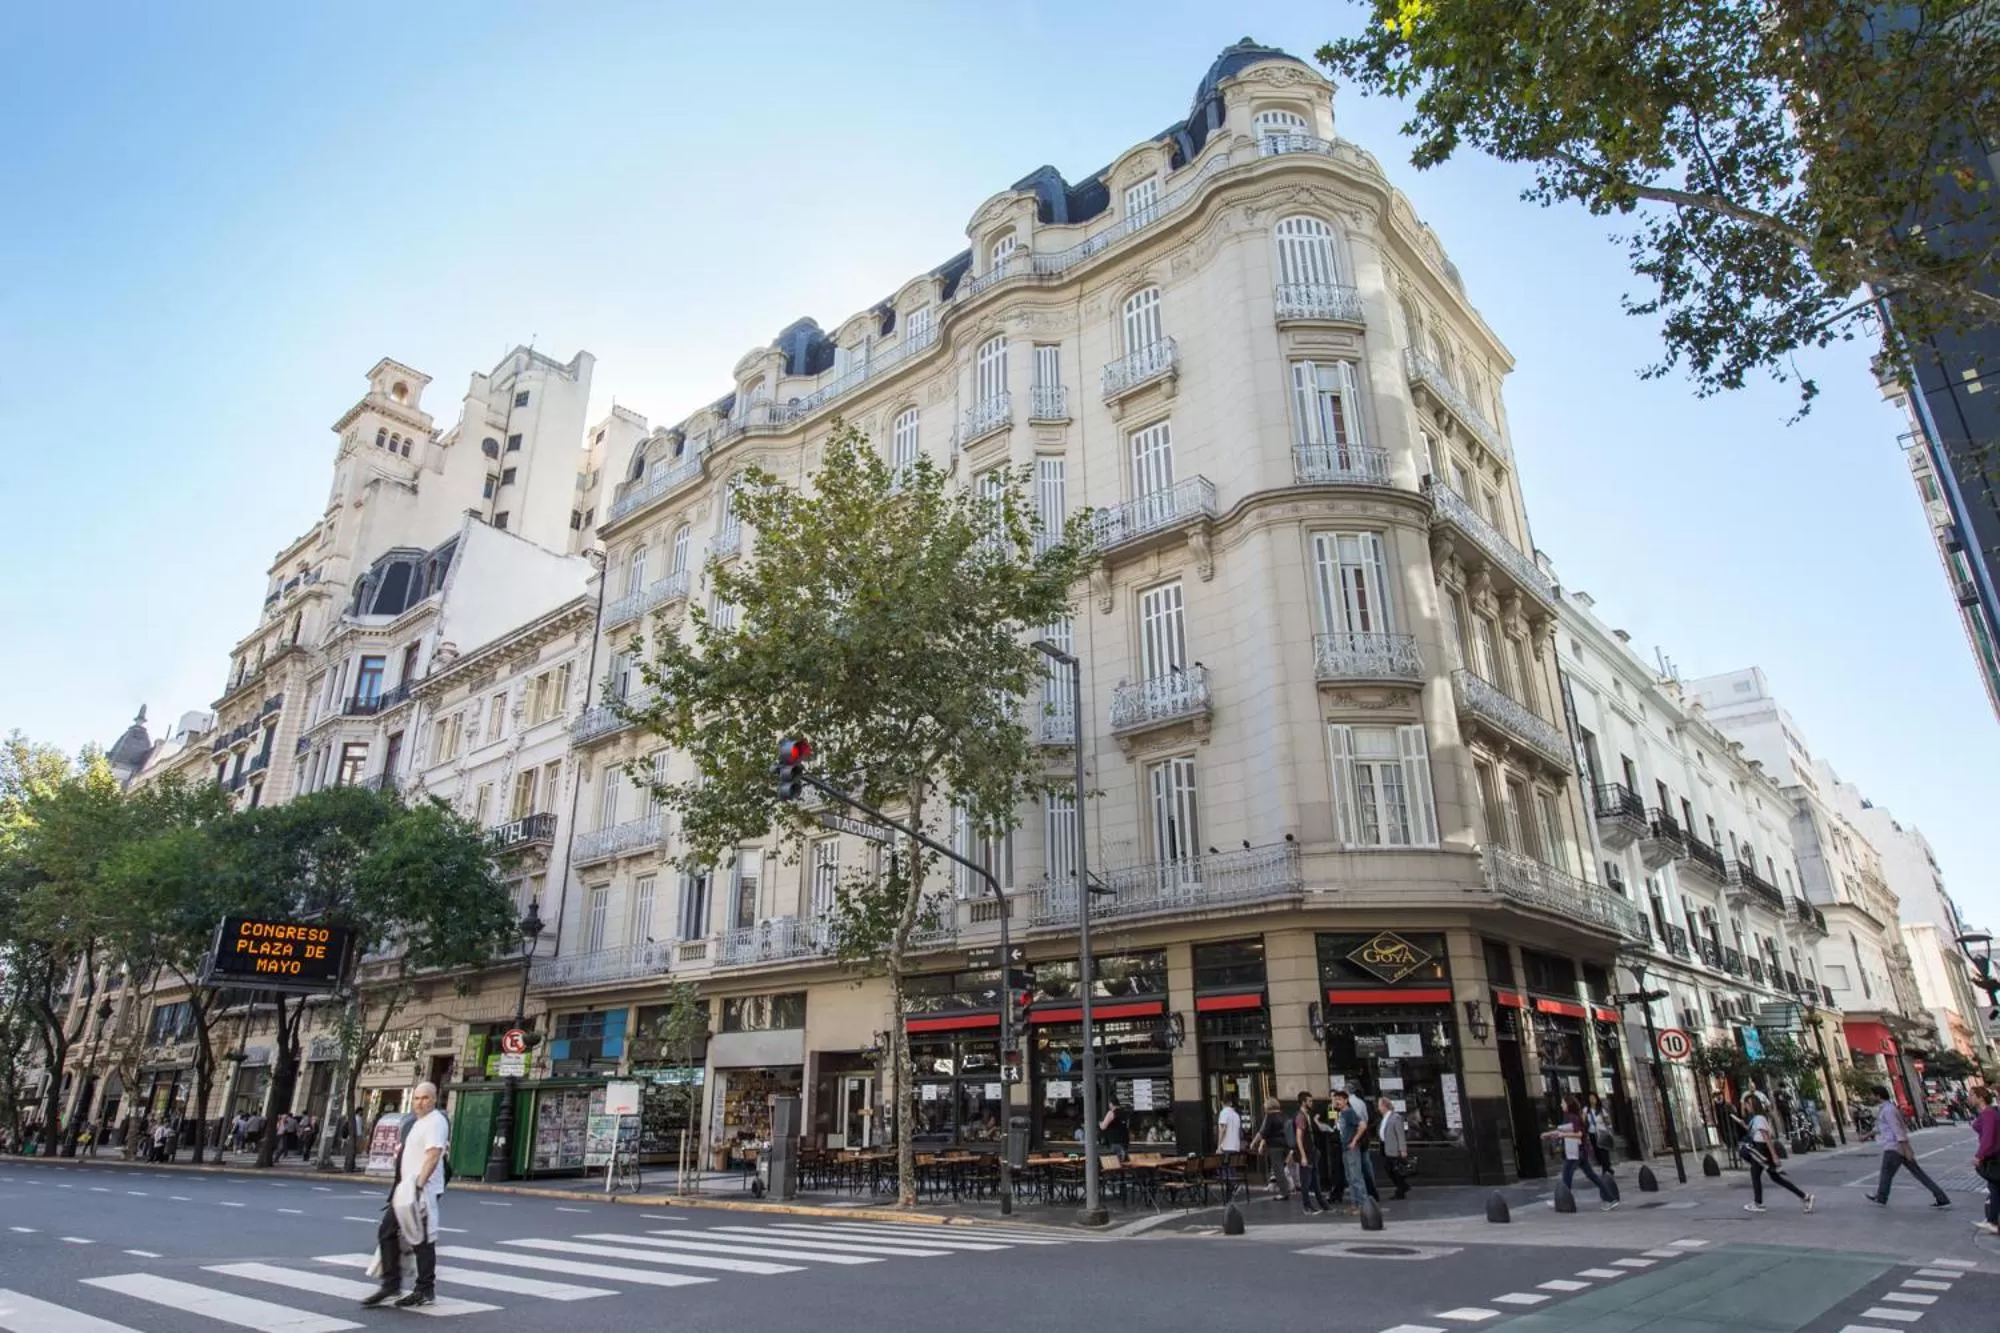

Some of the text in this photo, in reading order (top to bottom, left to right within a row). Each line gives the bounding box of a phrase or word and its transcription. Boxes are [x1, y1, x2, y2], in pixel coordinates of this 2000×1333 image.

[240, 921, 329, 942] CONGRESO
[236, 939, 327, 959] PLAZA DE
[256, 959, 301, 974] MAYO
[1663, 1036, 1683, 1052] 10
